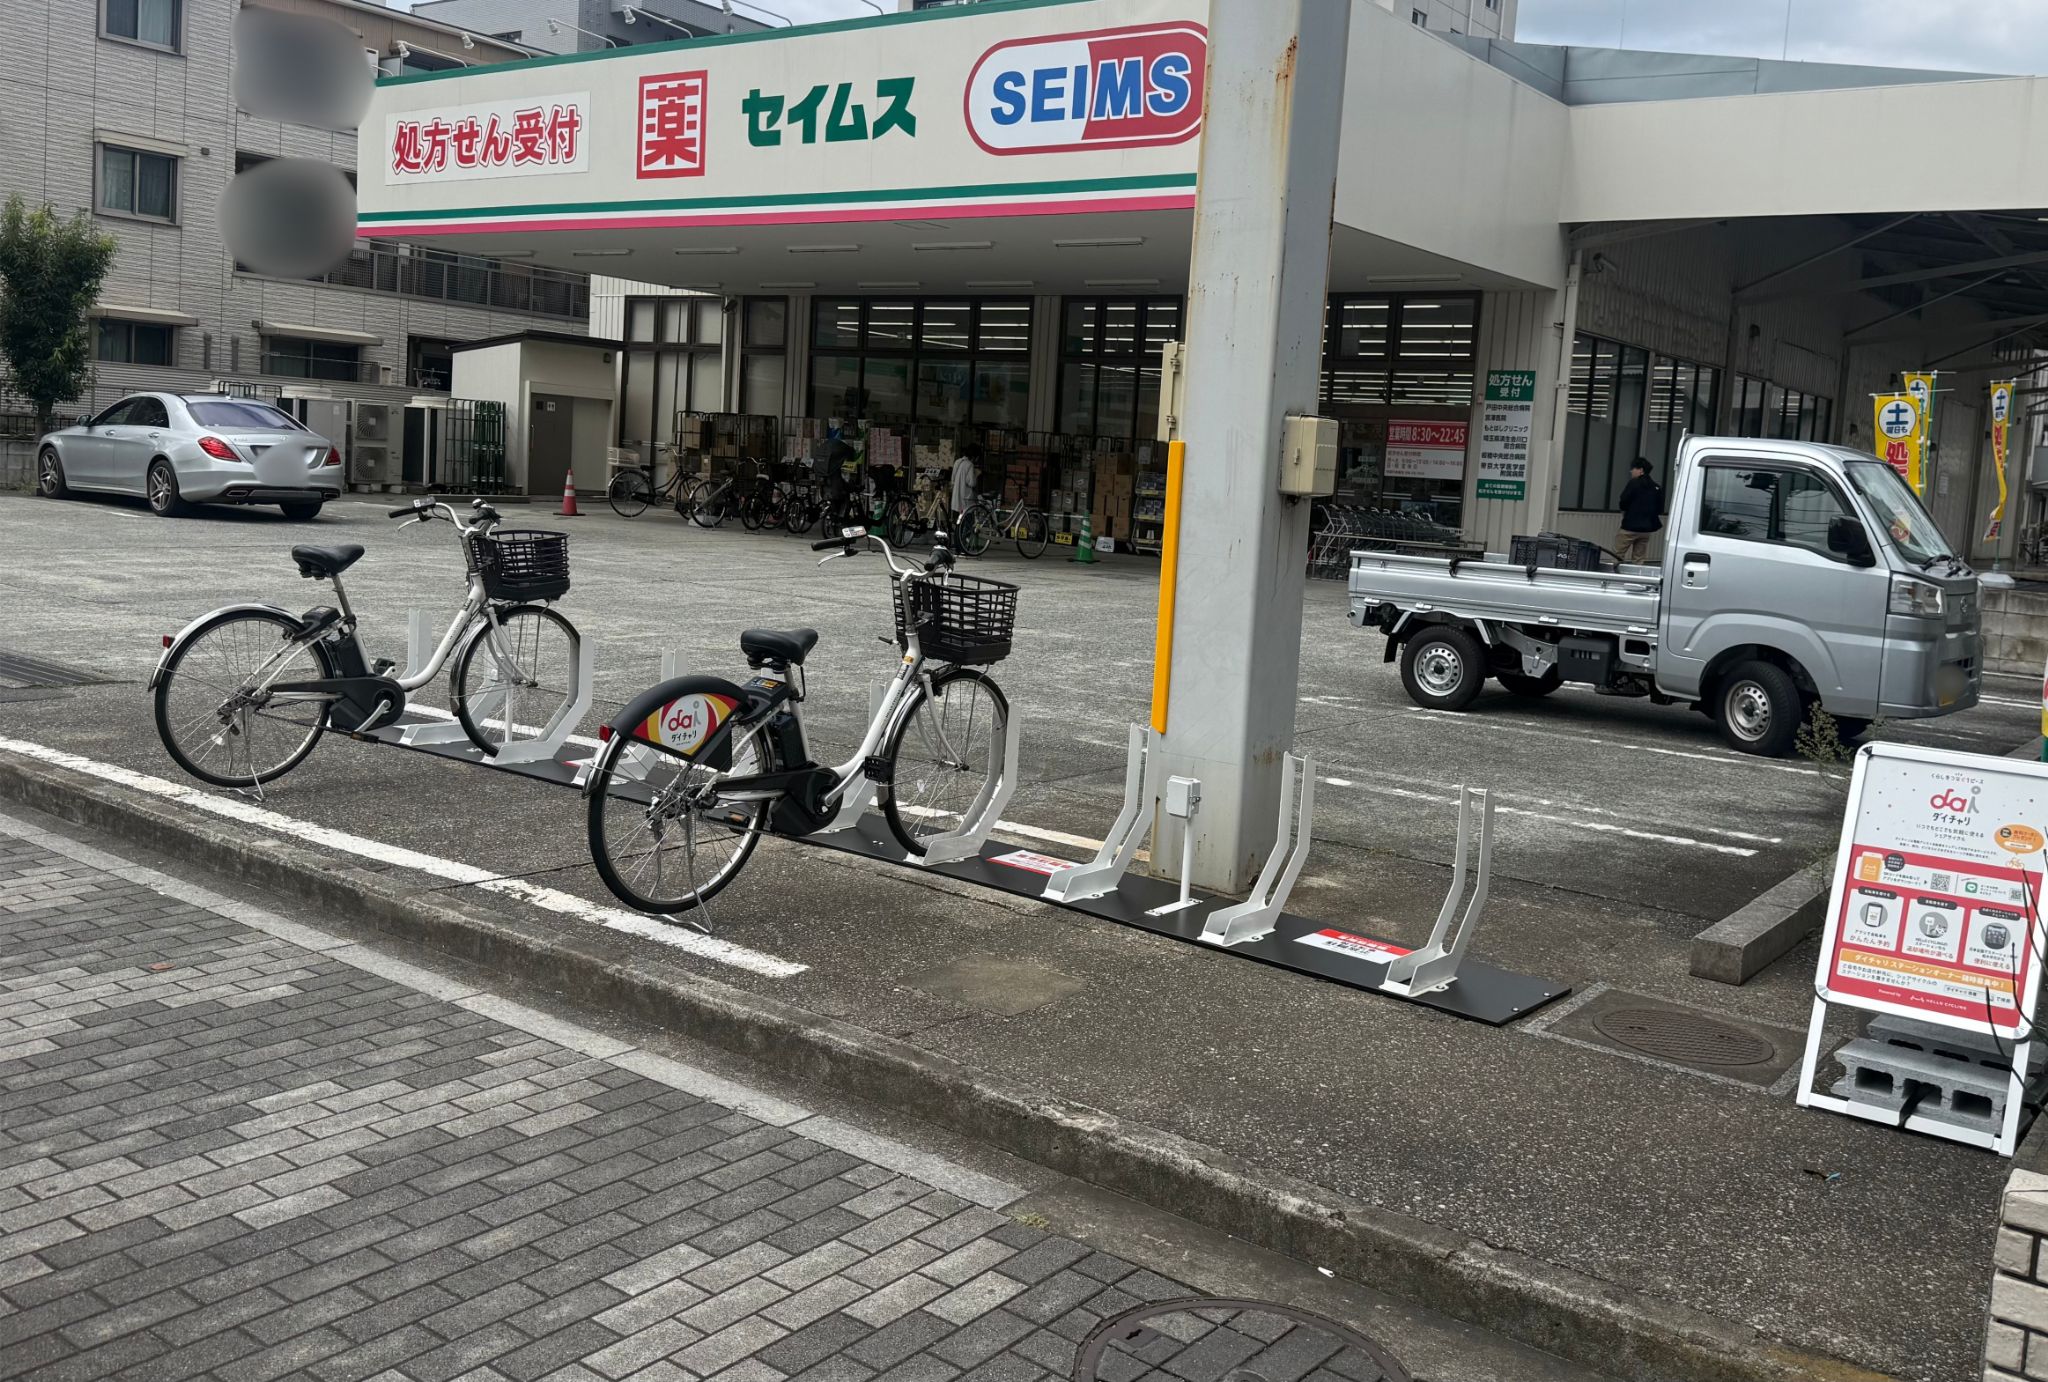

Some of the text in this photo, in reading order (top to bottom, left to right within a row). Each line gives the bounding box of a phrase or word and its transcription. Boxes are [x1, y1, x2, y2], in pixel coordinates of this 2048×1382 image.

[990, 53, 1192, 125] SEIMS
[742, 76, 916, 147] セイムス
[643, 82, 700, 167] 薬
[391, 104, 582, 175] 処方せん受付
[1489, 374, 1533, 386] 処方せん
[1499, 387, 1520, 397] 受付
[1886, 403, 1908, 425] 土
[671, 730, 697, 743] ダイチャリ
[1932, 812, 1971, 826] ダイチャリ
[1849, 934, 1889, 947] かんたん予約
